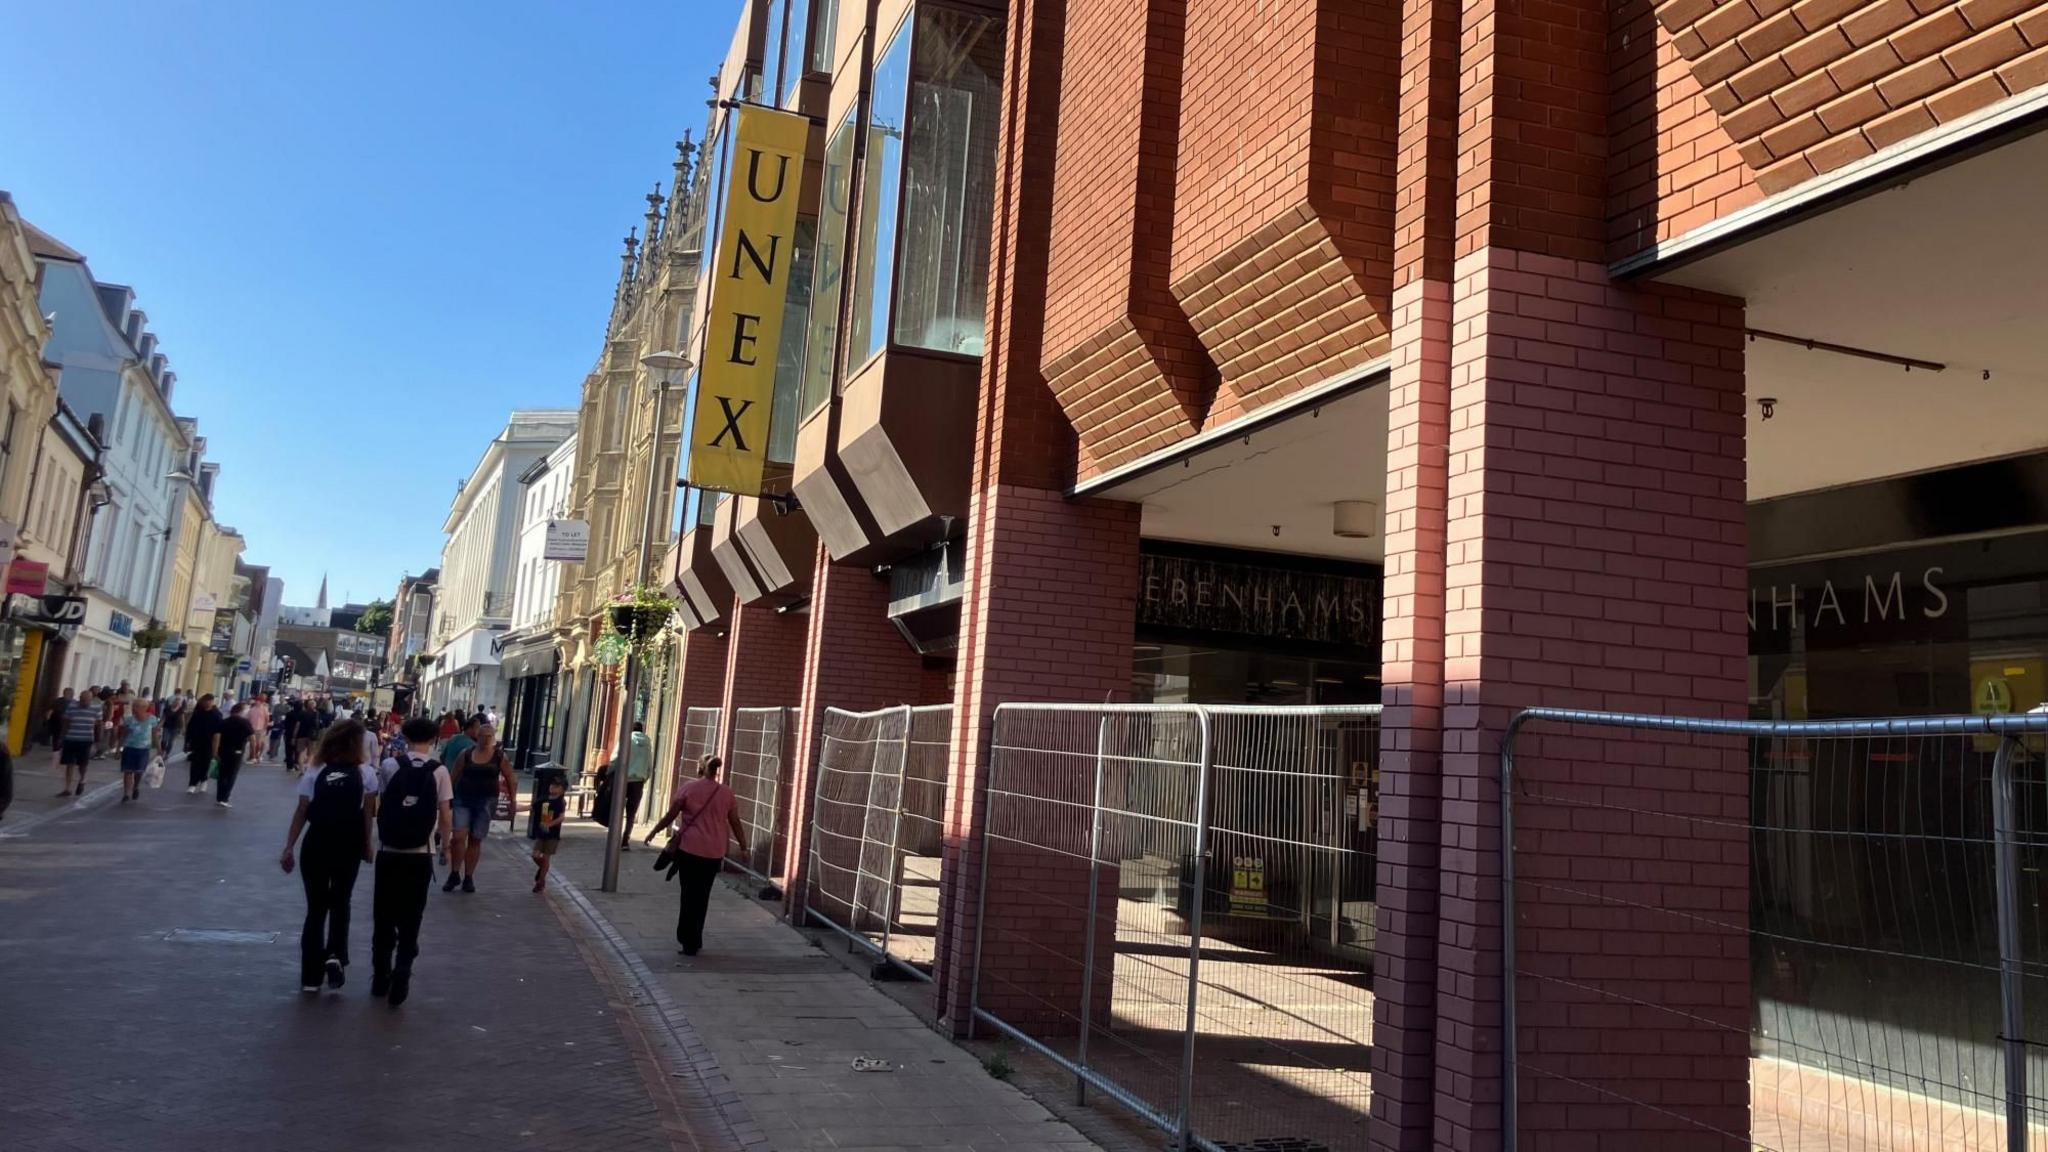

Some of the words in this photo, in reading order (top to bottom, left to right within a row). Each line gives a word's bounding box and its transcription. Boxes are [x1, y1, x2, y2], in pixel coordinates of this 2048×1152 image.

[707, 148, 793, 452] UNEX
[53, 601, 84, 619] JD
[1145, 575, 1366, 623] EBENHAMS
